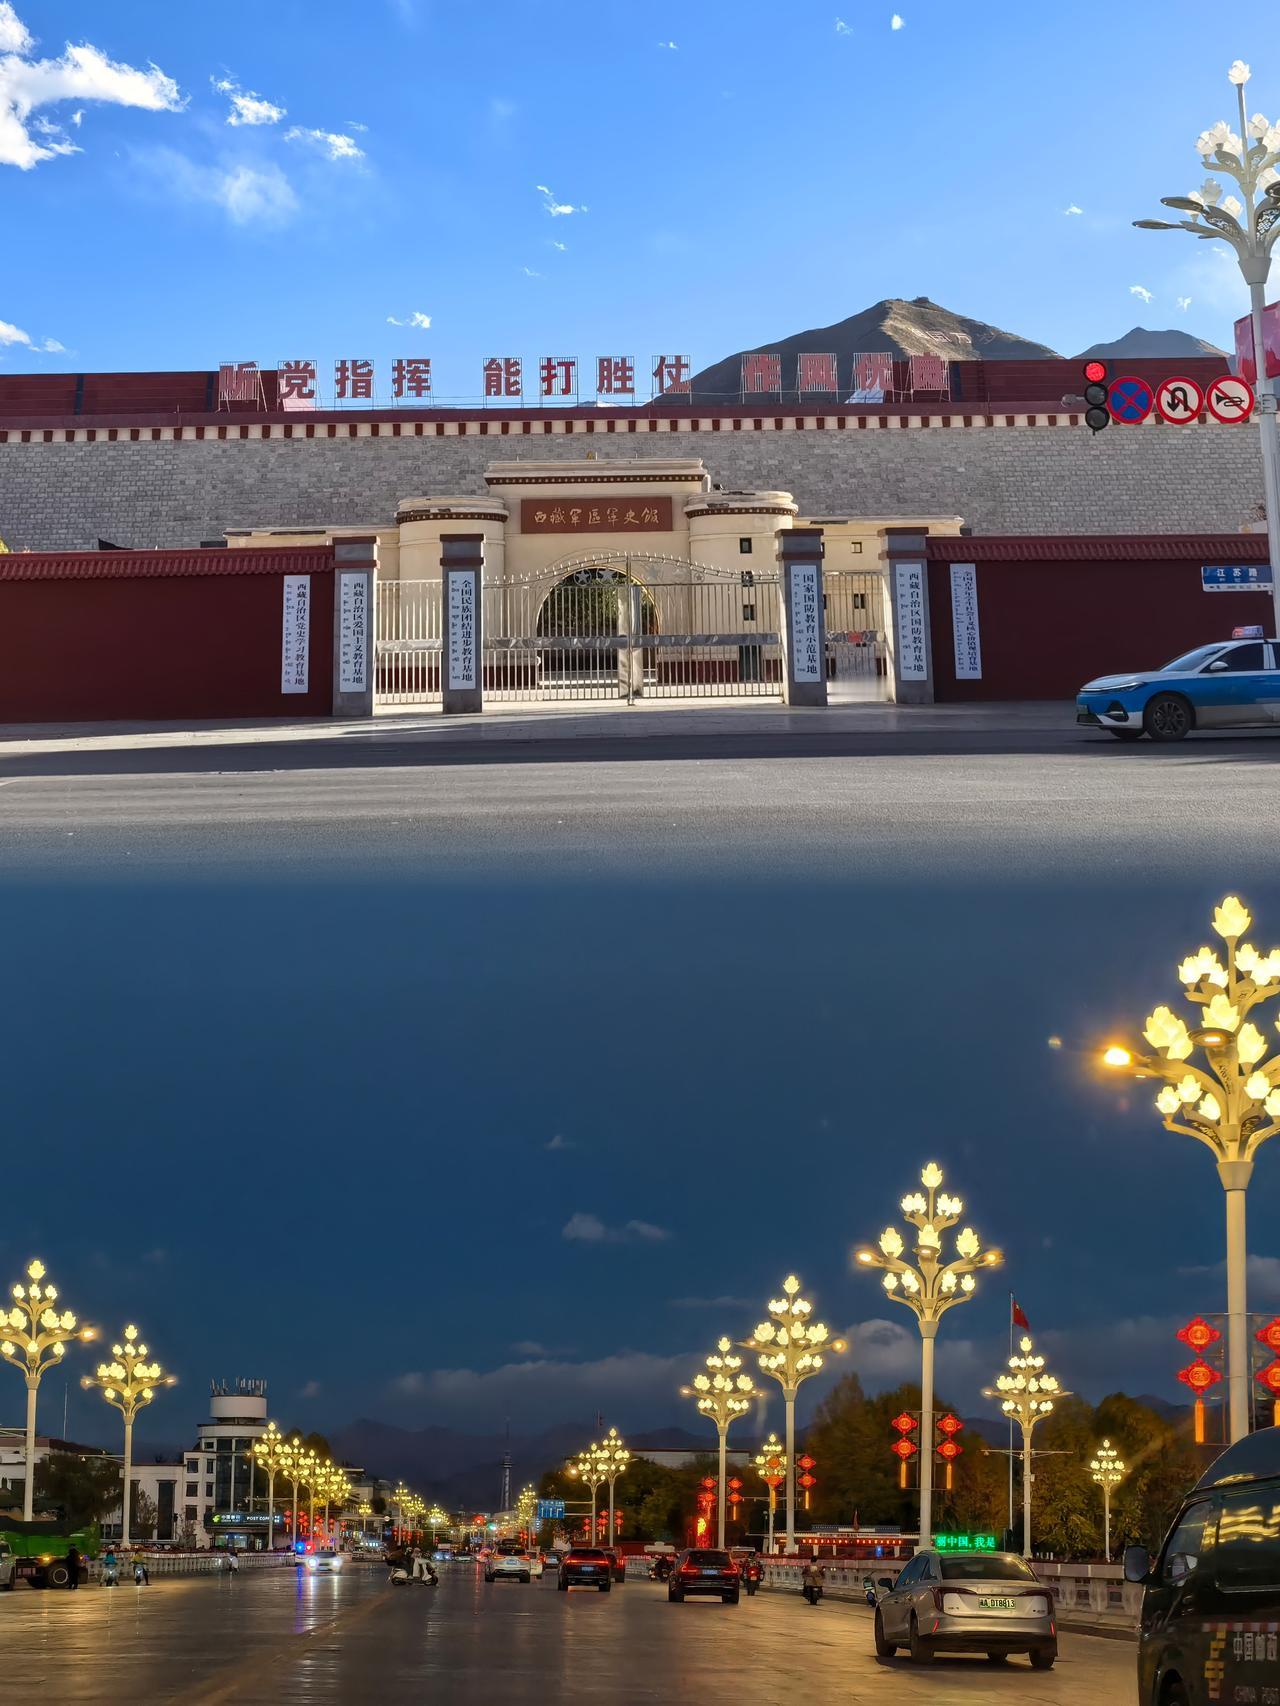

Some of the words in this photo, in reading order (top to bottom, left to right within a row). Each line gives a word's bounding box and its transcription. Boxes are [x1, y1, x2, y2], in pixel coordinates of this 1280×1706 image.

[219, 359, 432, 399] 听党指挥
[484, 355, 690, 397] 能打胜仗
[352, 582, 364, 684] 西藏自治区爱国主义教育基地
[461, 579, 473, 682] 全国民族团结进步教育基地
[803, 573, 818, 674] 国家国防教育示范基地
[909, 572, 925, 673] 西藏自治区国防教育基地
